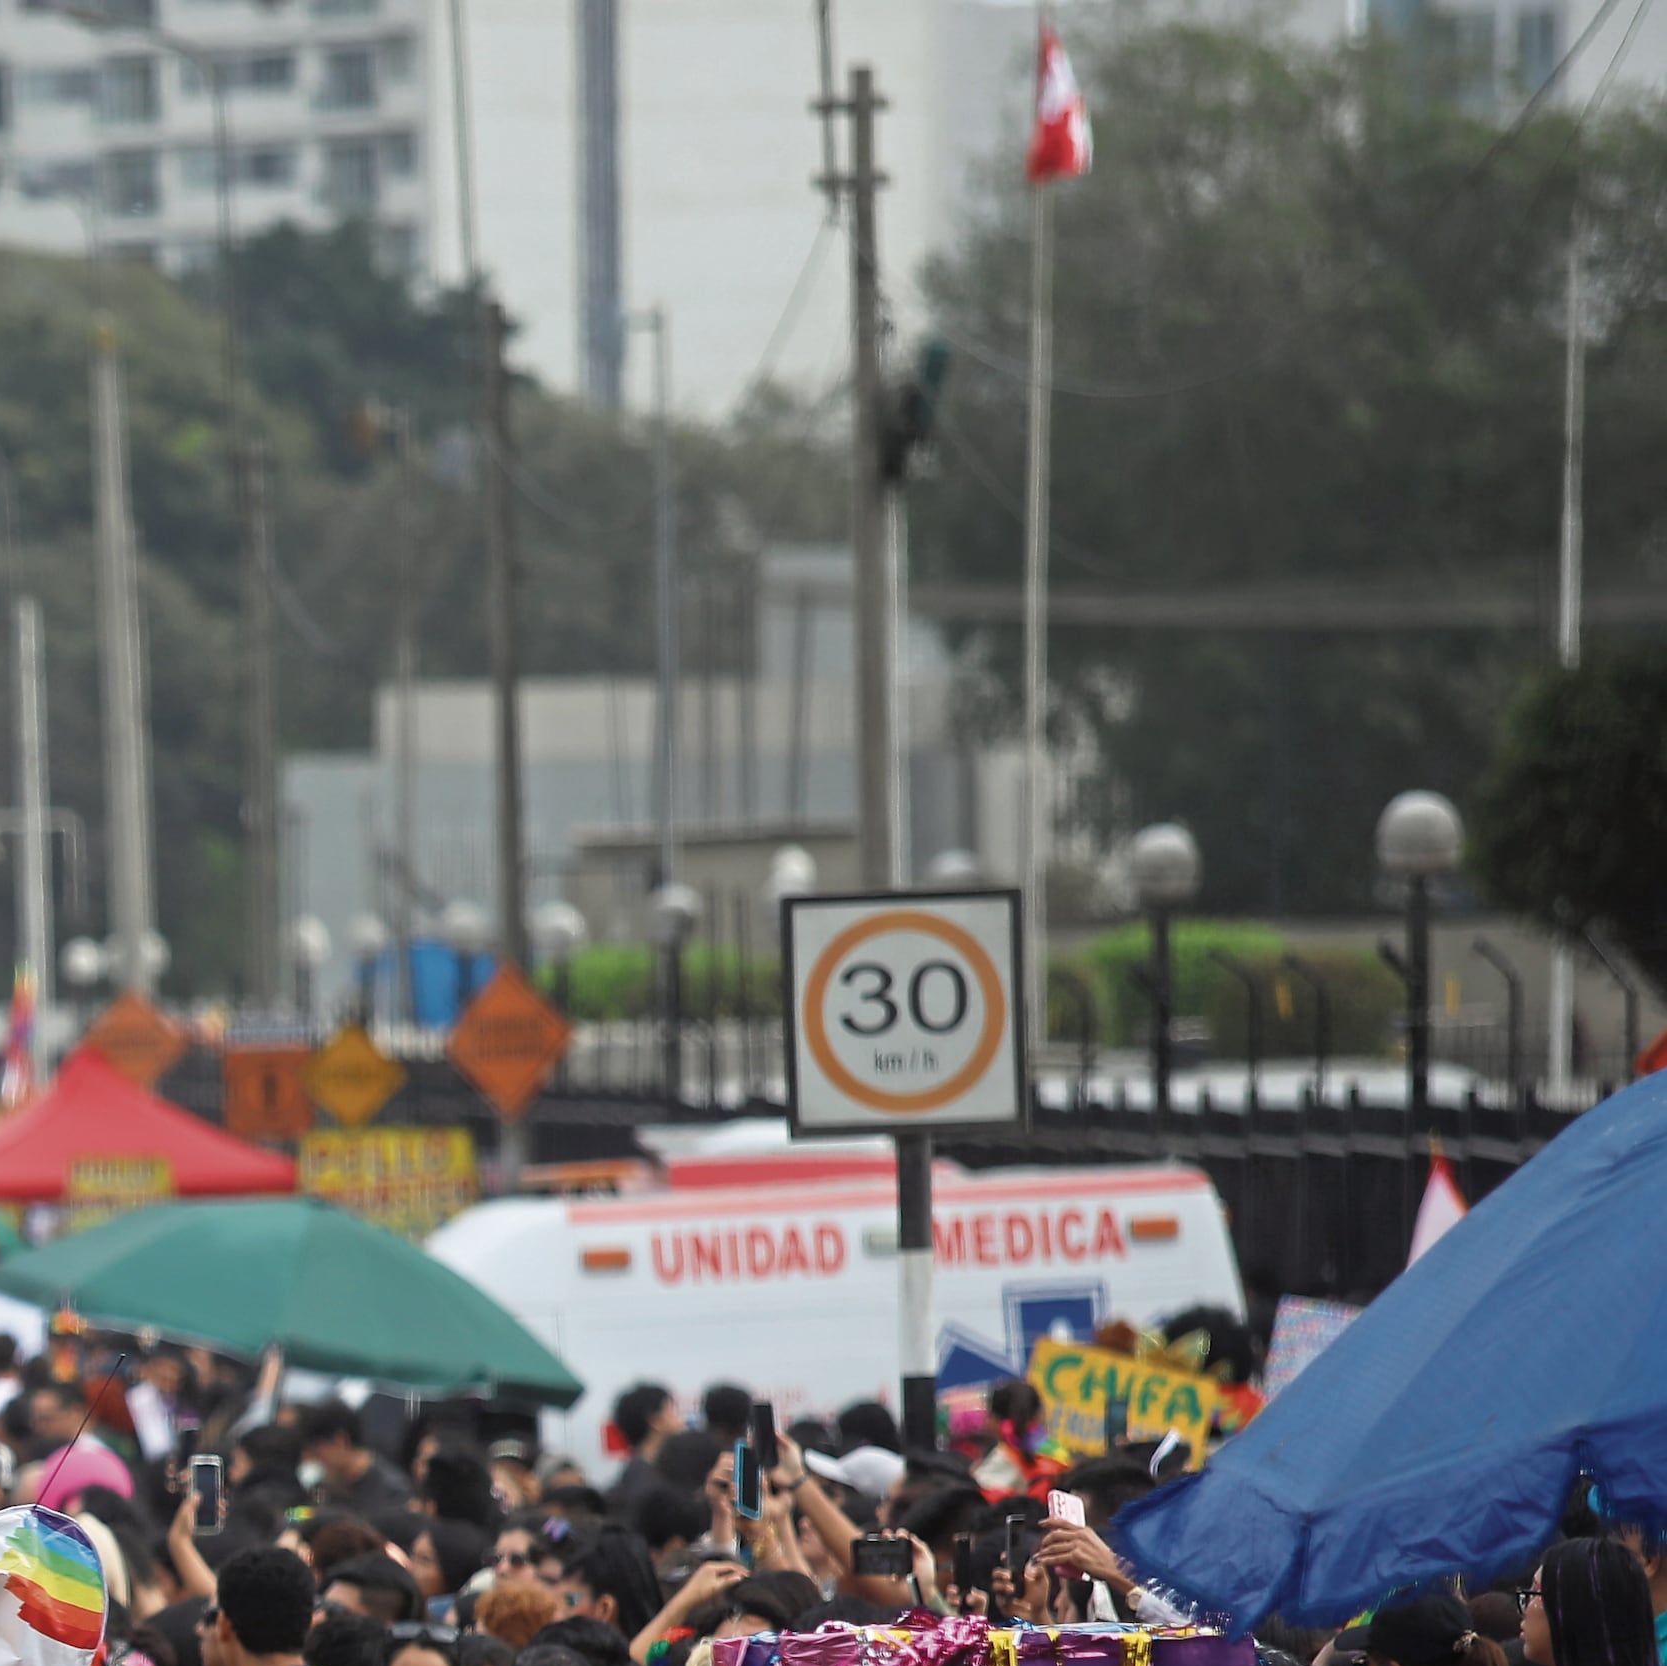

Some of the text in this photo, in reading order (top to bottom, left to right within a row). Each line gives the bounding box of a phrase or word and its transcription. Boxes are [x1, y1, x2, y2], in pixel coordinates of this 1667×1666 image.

[842, 962, 968, 1035] 30
[652, 1207, 1126, 1284] UNIDAD MEDICA
[1045, 1354, 1203, 1425] CHIFA
